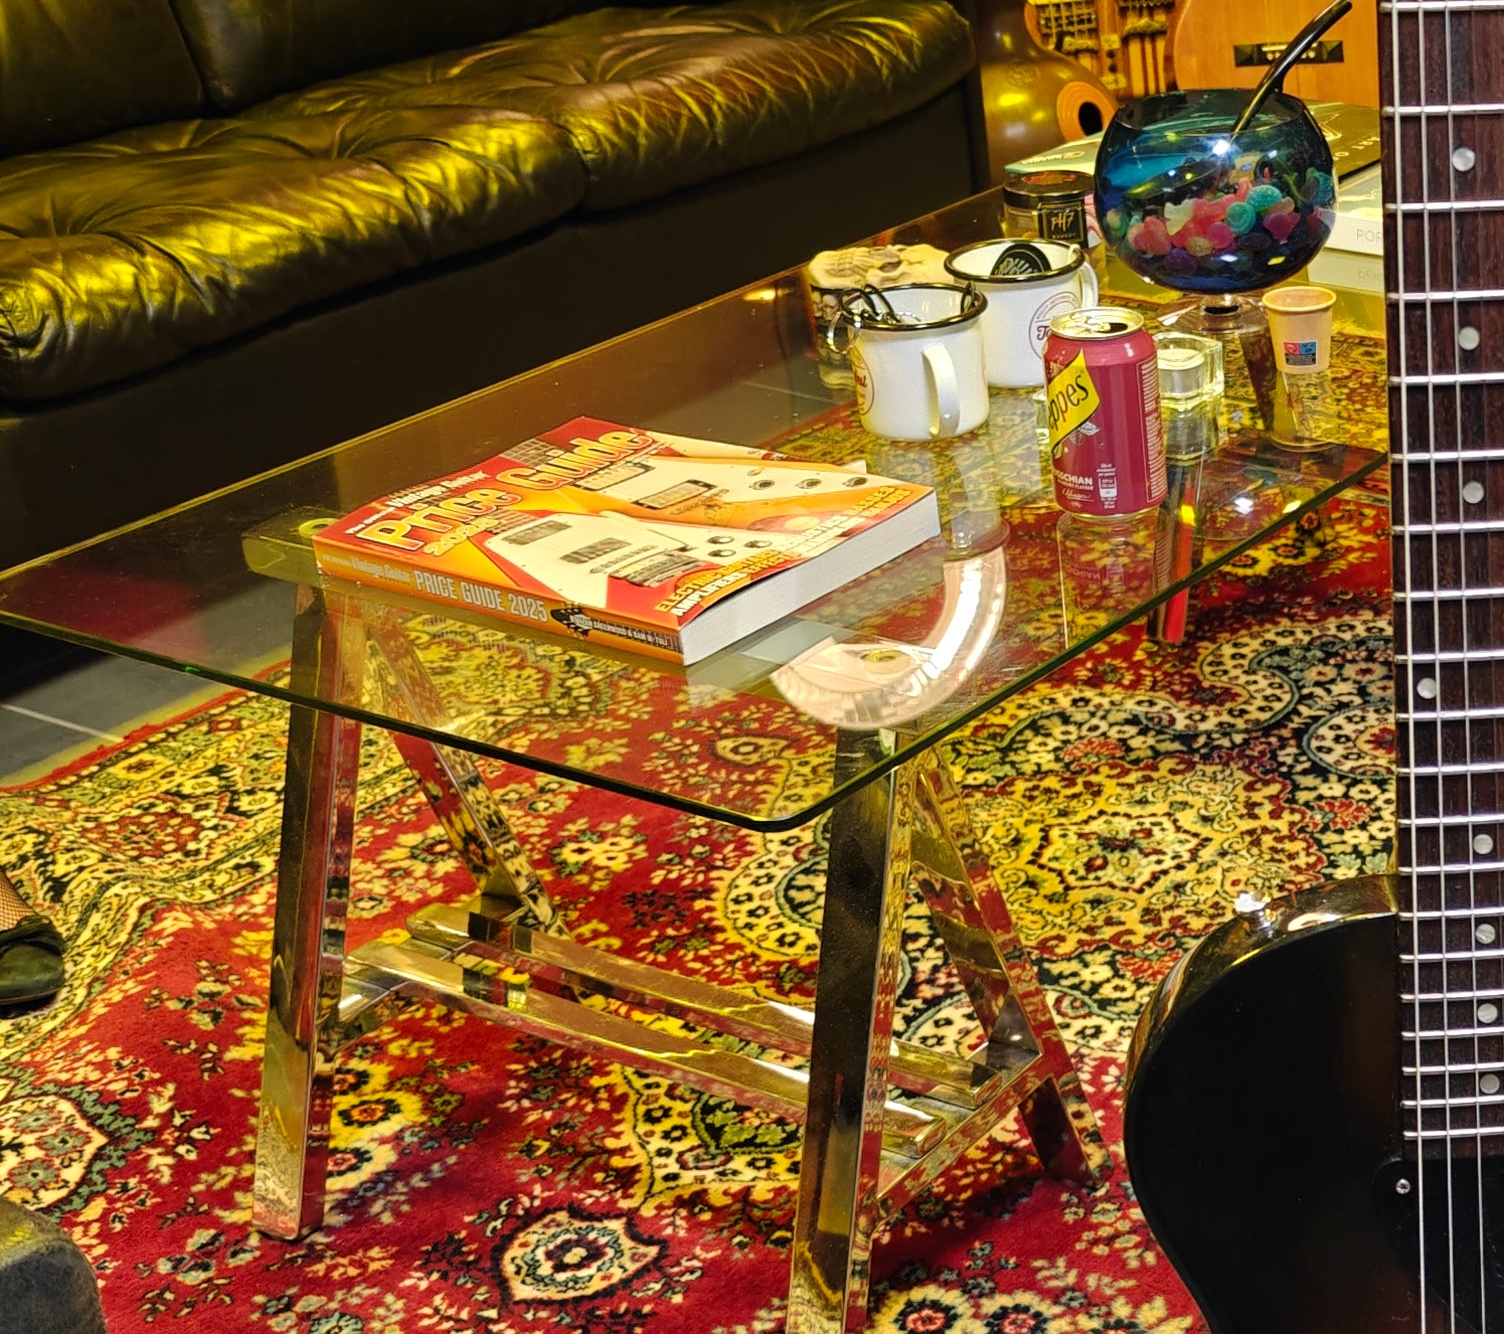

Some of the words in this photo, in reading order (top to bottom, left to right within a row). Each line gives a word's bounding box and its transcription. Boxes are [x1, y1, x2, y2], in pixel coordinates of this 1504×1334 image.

[355, 488, 522, 551] Price
[496, 431, 654, 490] Guide
[413, 569, 458, 600] PRICE
[460, 581, 505, 612] GUIDE
[507, 592, 548, 622] 2025
[654, 572, 722, 612] ELECTRIC
[670, 571, 748, 617] AMPLIFIERS
